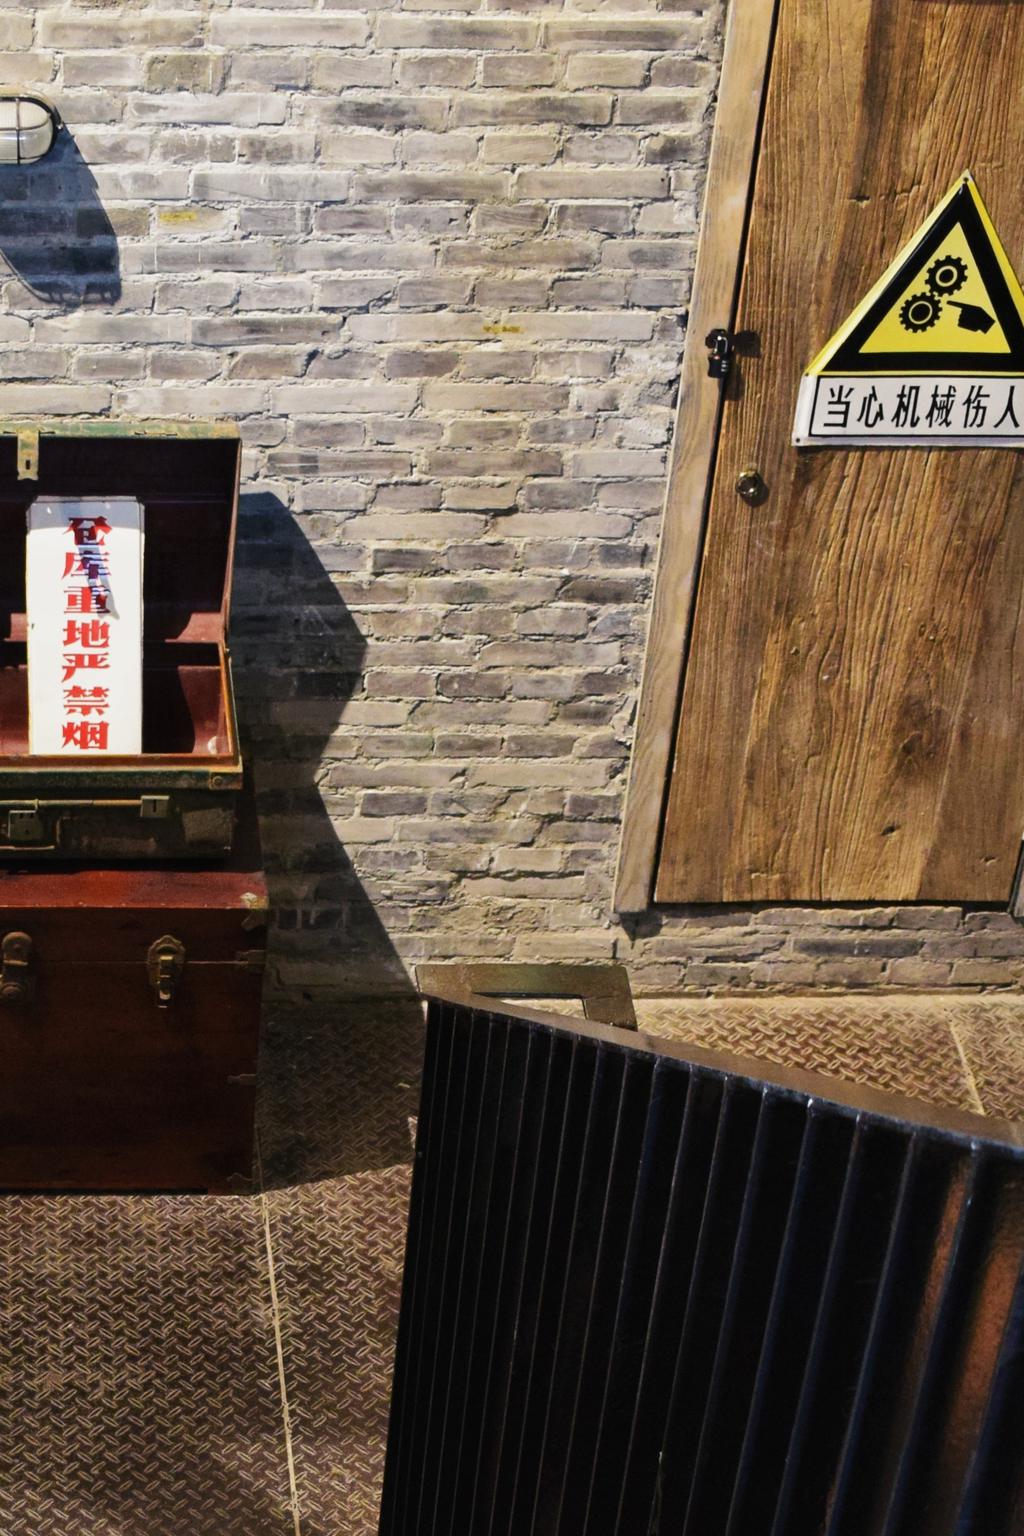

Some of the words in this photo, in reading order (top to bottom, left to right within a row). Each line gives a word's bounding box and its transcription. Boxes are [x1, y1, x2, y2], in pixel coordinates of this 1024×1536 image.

[823, 384, 1020, 429] 当心机械伤人
[61, 516, 113, 751] 仓库重地严禁烟
